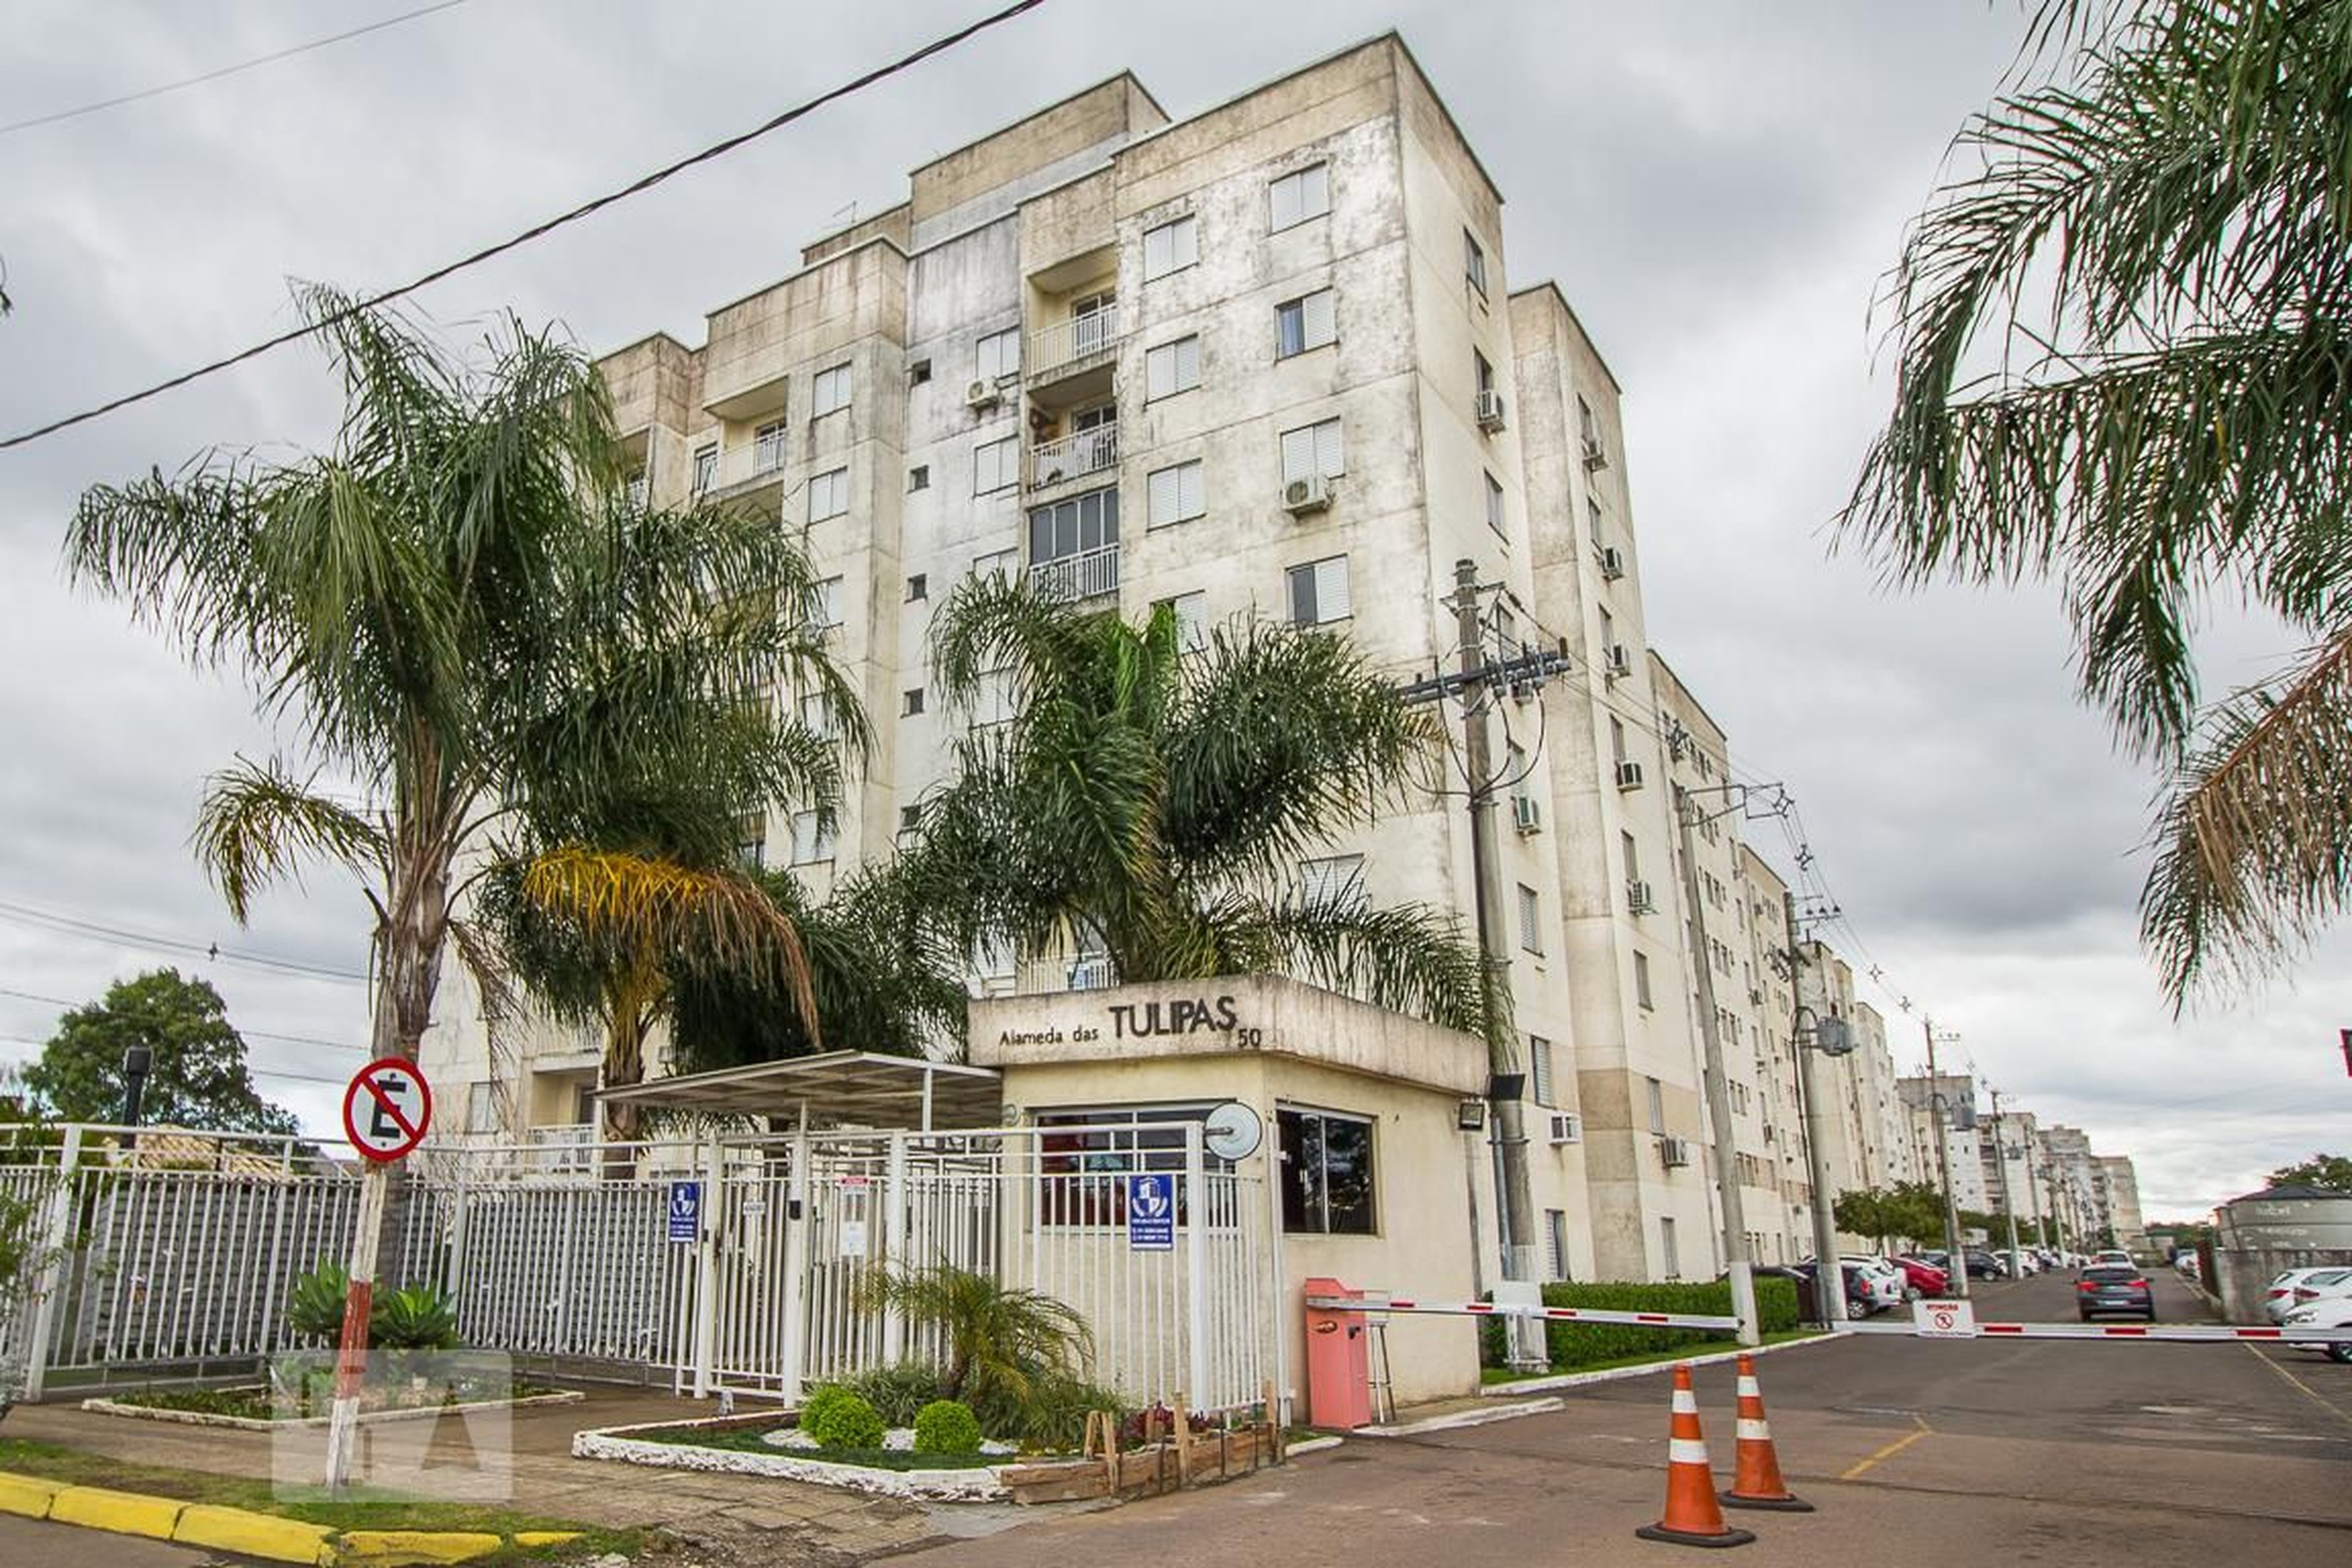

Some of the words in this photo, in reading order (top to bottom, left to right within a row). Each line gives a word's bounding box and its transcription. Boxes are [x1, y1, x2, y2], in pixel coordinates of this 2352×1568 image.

[999, 1027, 1063, 1046] Alameda
[1072, 1025, 1099, 1041] das
[1108, 995, 1238, 1039] TULIPAS
[1237, 1028, 1261, 1048] 50
